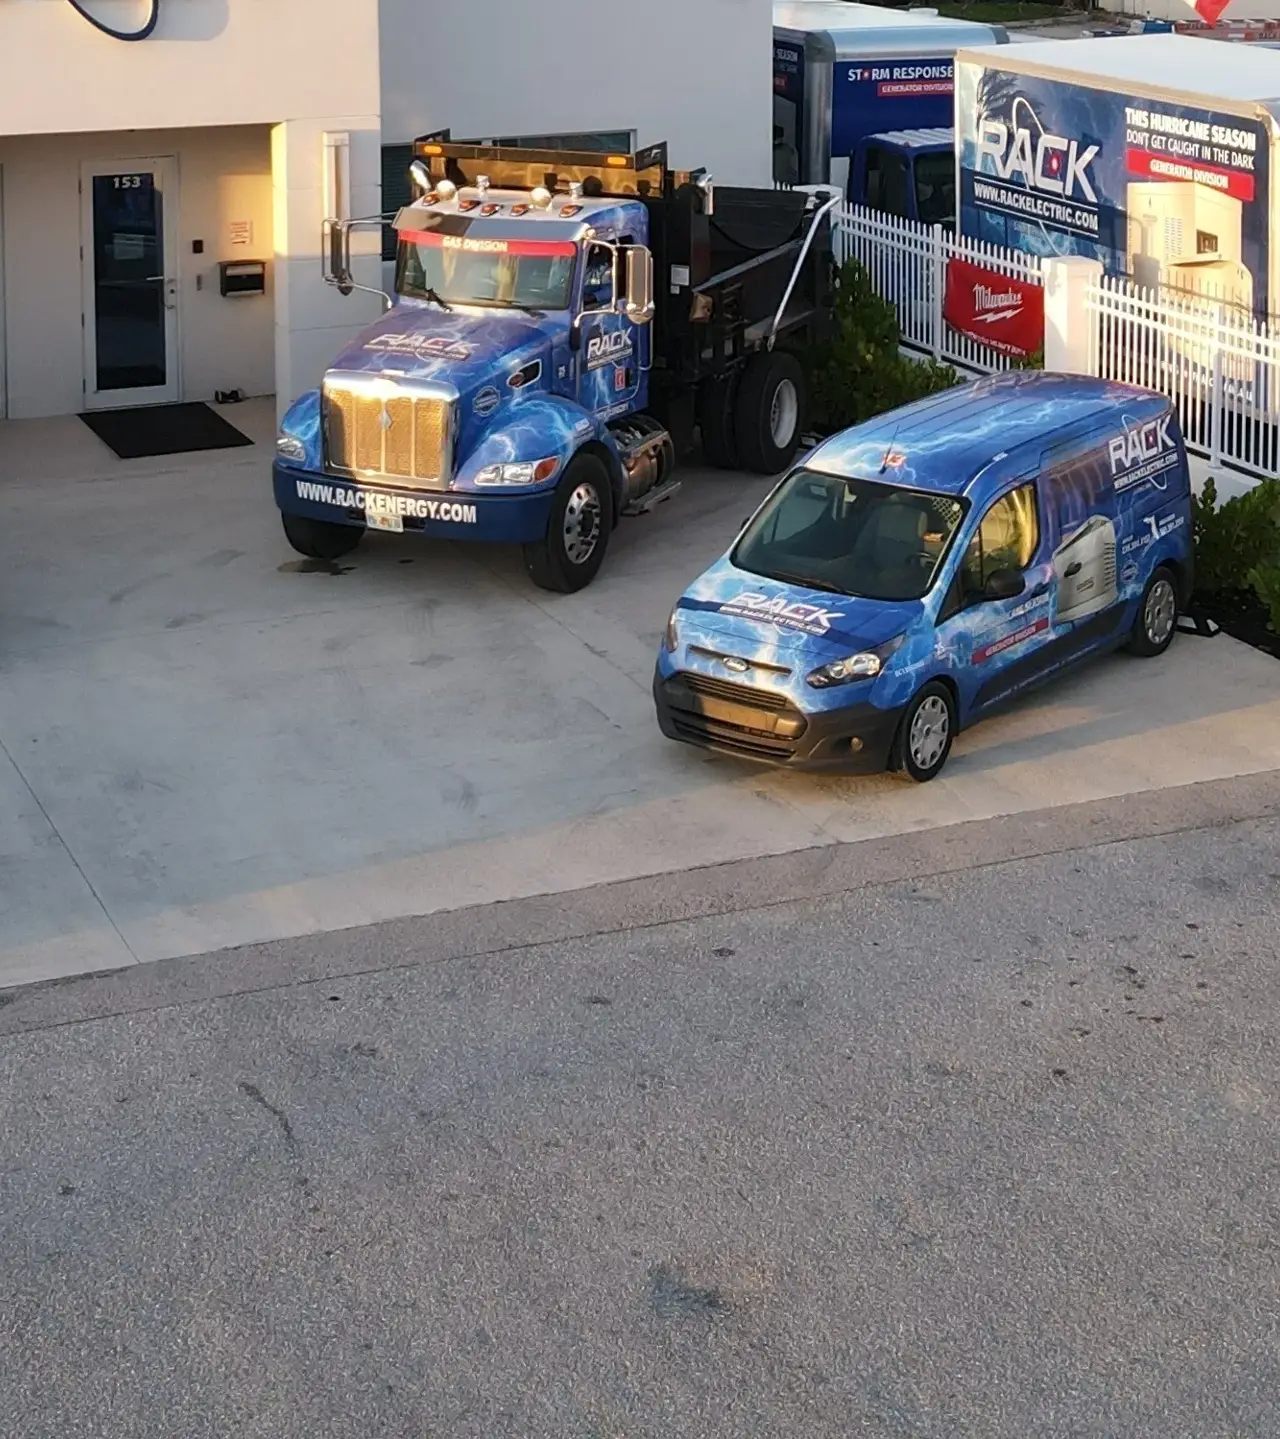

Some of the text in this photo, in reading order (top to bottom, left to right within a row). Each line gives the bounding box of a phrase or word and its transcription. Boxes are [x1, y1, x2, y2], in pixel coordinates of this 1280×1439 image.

[893, 65, 953, 80] RESPONSE
[1124, 107, 1256, 151] THIS HURRICANE SEASON
[974, 118, 1100, 203] RACK
[1151, 134, 1167, 150] GET
[1168, 138, 1200, 158] CAUGHT
[1201, 145, 1211, 161] IN
[1212, 148, 1230, 165] THE
[1231, 152, 1255, 170] DARK
[113, 176, 141, 189] 153
[1150, 158, 1229, 189] GENERATOR DIVISION
[974, 181, 1099, 231] WWW.RACKELECTRIC.COM
[442, 236, 508, 252] GAS DIVISION
[369, 333, 480, 356] RACK
[587, 326, 633, 359] RACK
[1109, 415, 1176, 474] RACK
[296, 480, 477, 523] WWW.RACKENERGY.COM
[728, 592, 846, 628] RACK
